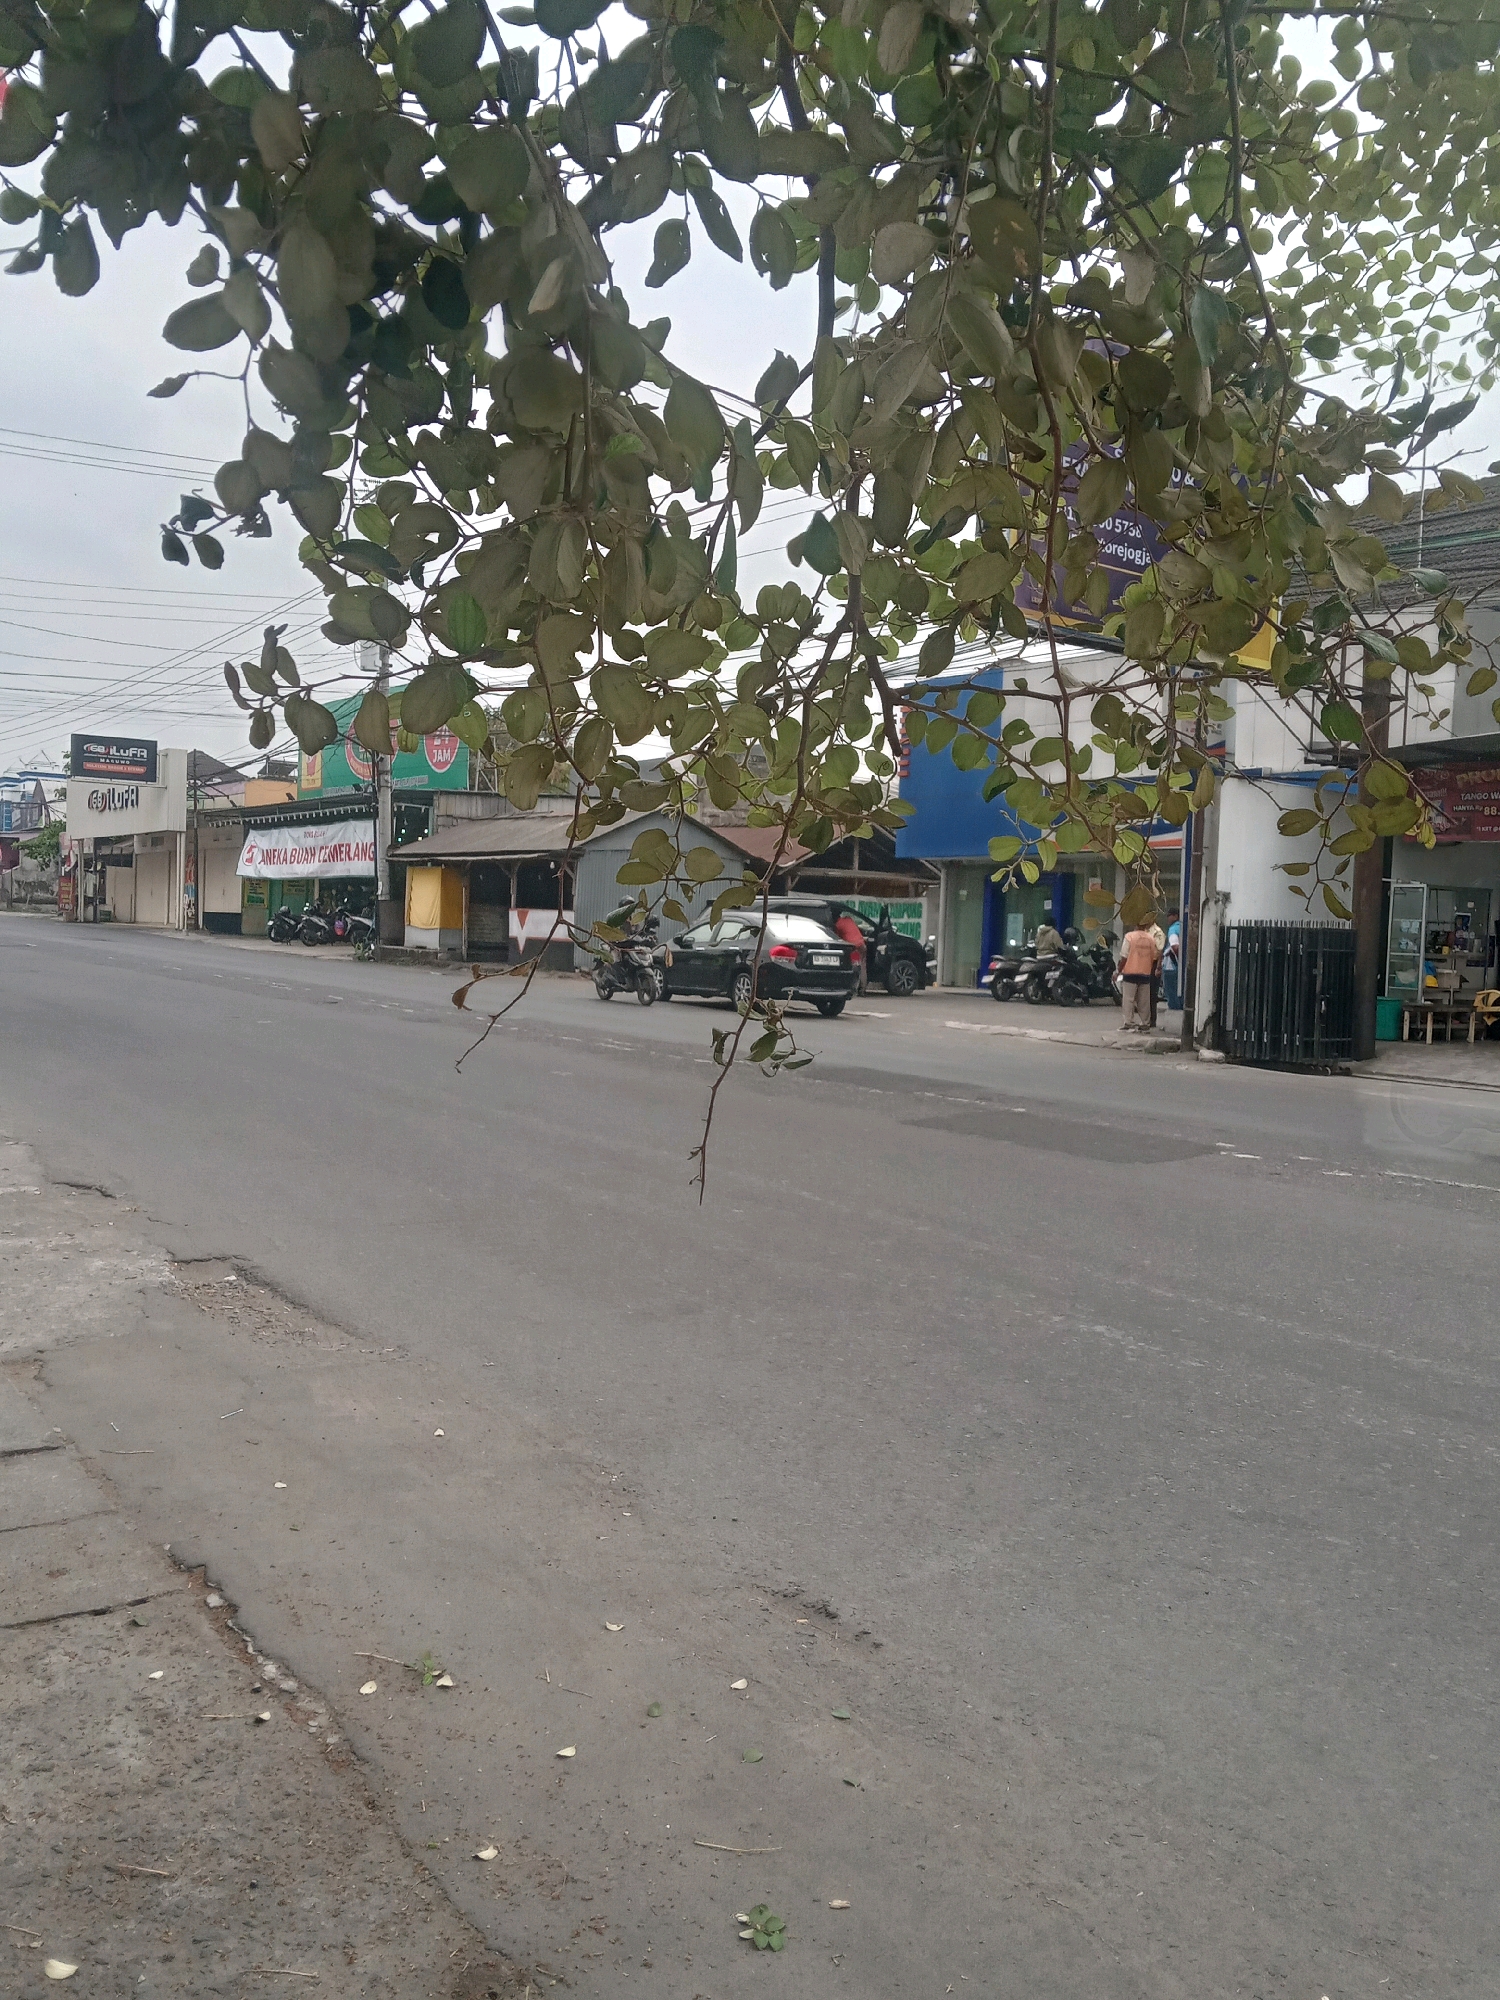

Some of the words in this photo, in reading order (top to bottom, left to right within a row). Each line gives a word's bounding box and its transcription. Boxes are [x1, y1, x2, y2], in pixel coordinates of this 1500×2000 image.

[432, 748, 451, 763] JAM
[1461, 792, 1489, 800] TANGO
[258, 847, 288, 866] ANEKA
[289, 845, 316, 864] BUAH
